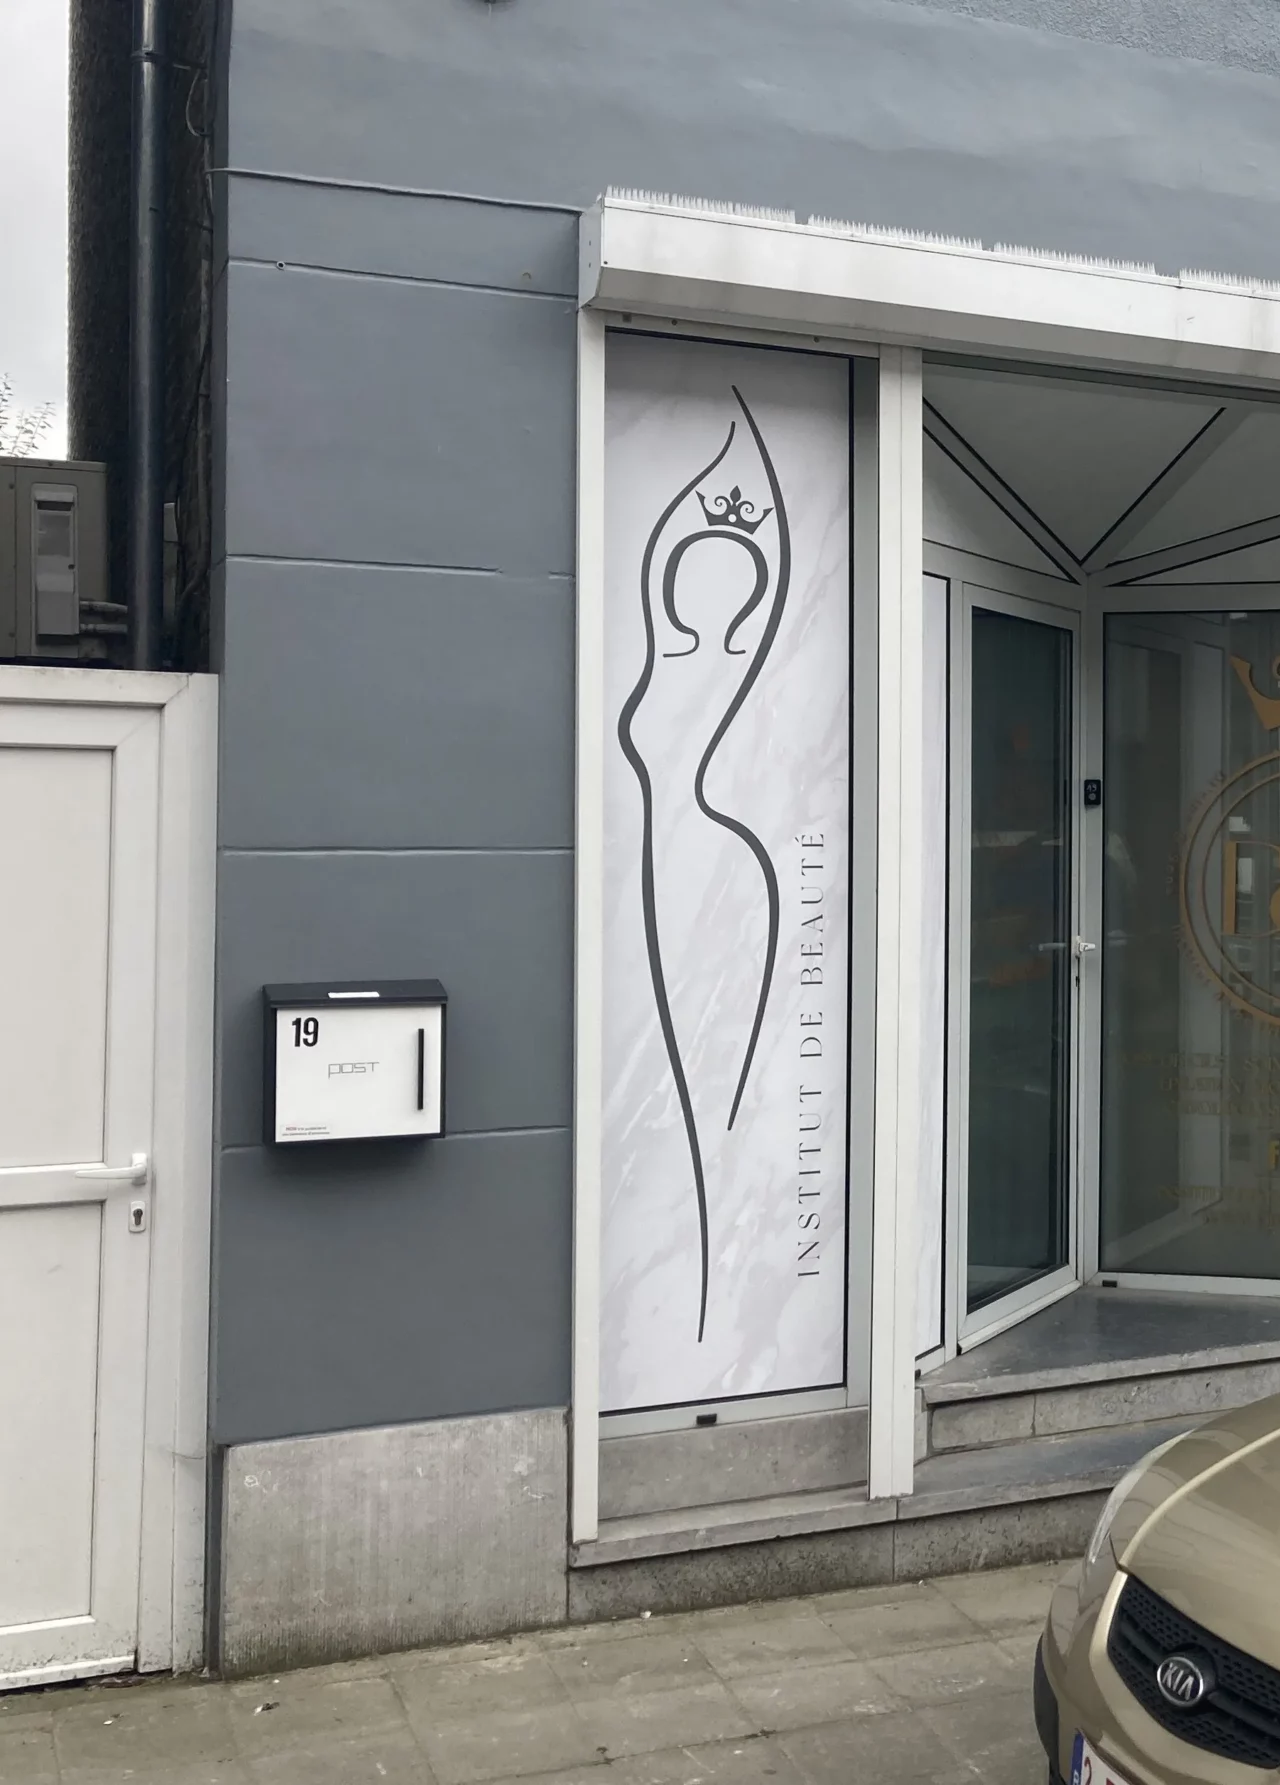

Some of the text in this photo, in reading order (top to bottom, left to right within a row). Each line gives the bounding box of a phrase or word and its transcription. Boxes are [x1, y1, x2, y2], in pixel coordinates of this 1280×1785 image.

[291, 1017, 320, 1048] 19
[794, 833, 824, 1277] INSTITUT DE BEAUTÉ
[1162, 1662, 1195, 1700] KIA
